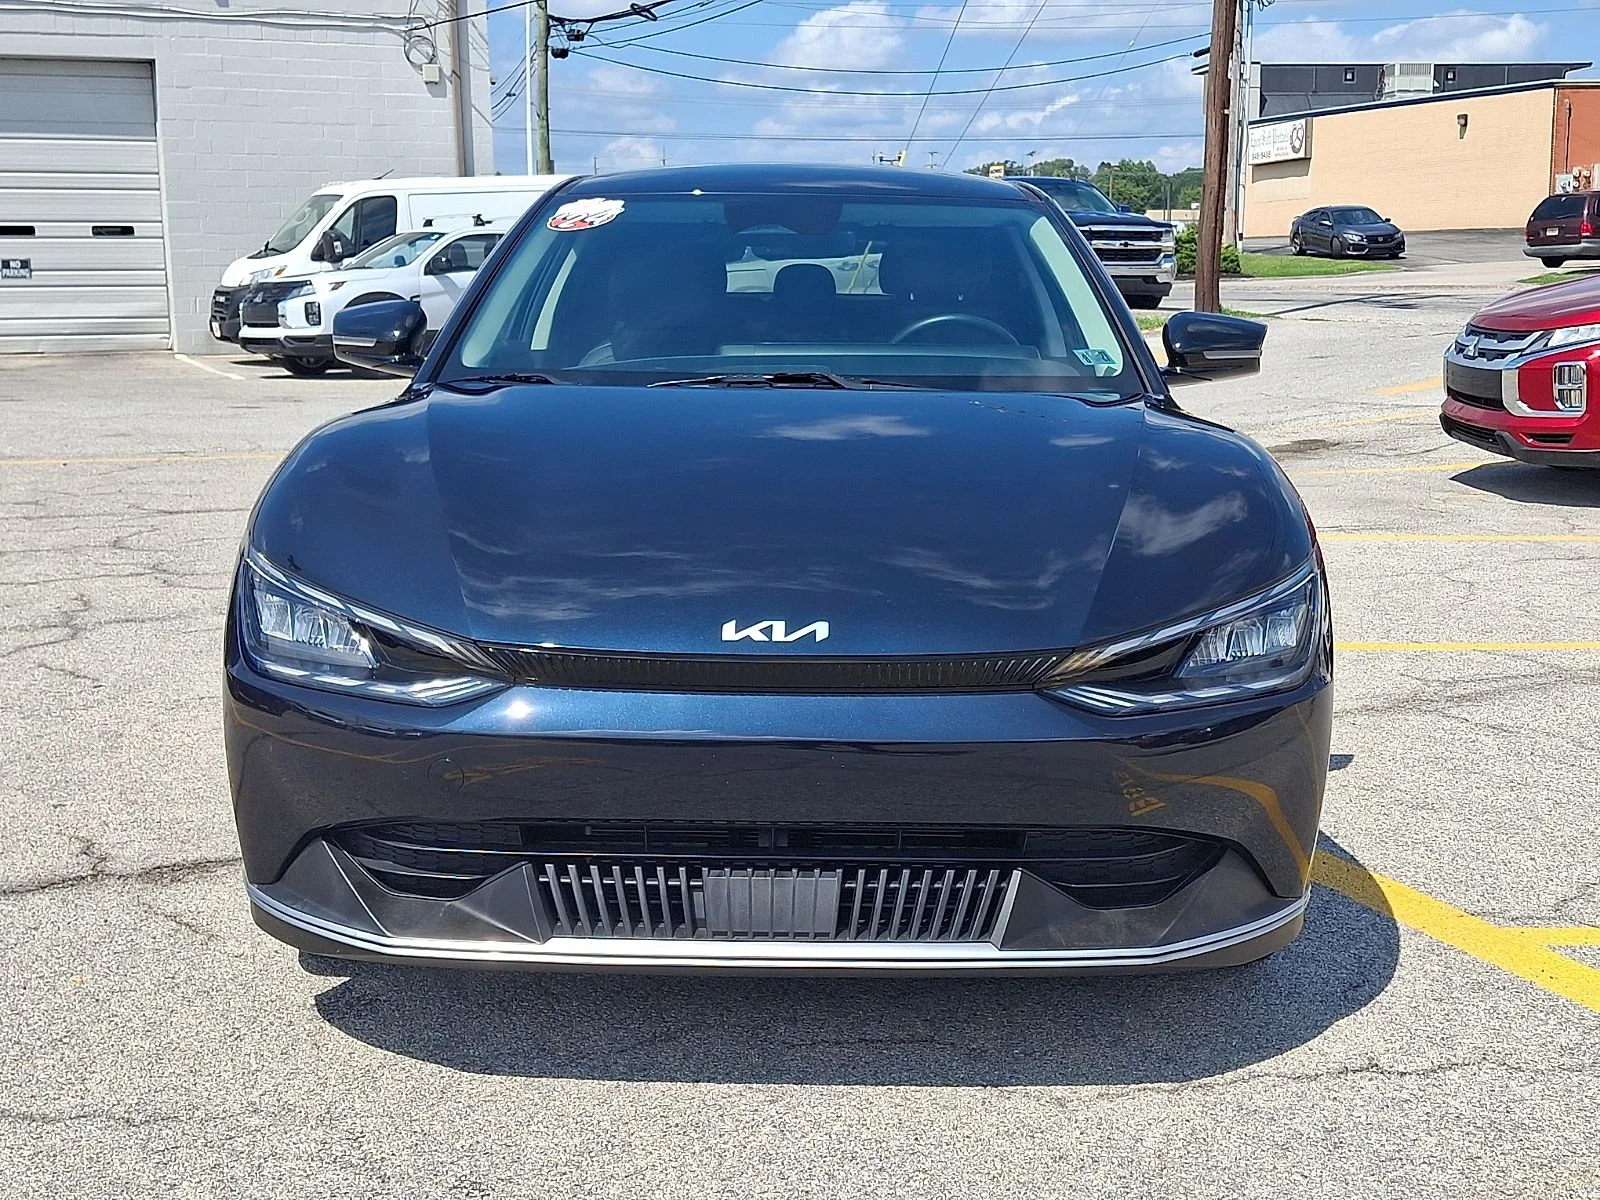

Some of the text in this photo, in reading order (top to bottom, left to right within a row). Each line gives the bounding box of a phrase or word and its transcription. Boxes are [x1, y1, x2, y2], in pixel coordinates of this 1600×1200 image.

[9, 260, 21, 268] NO
[2, 268, 30, 278] PARKING
[721, 619, 829, 643] KIA
